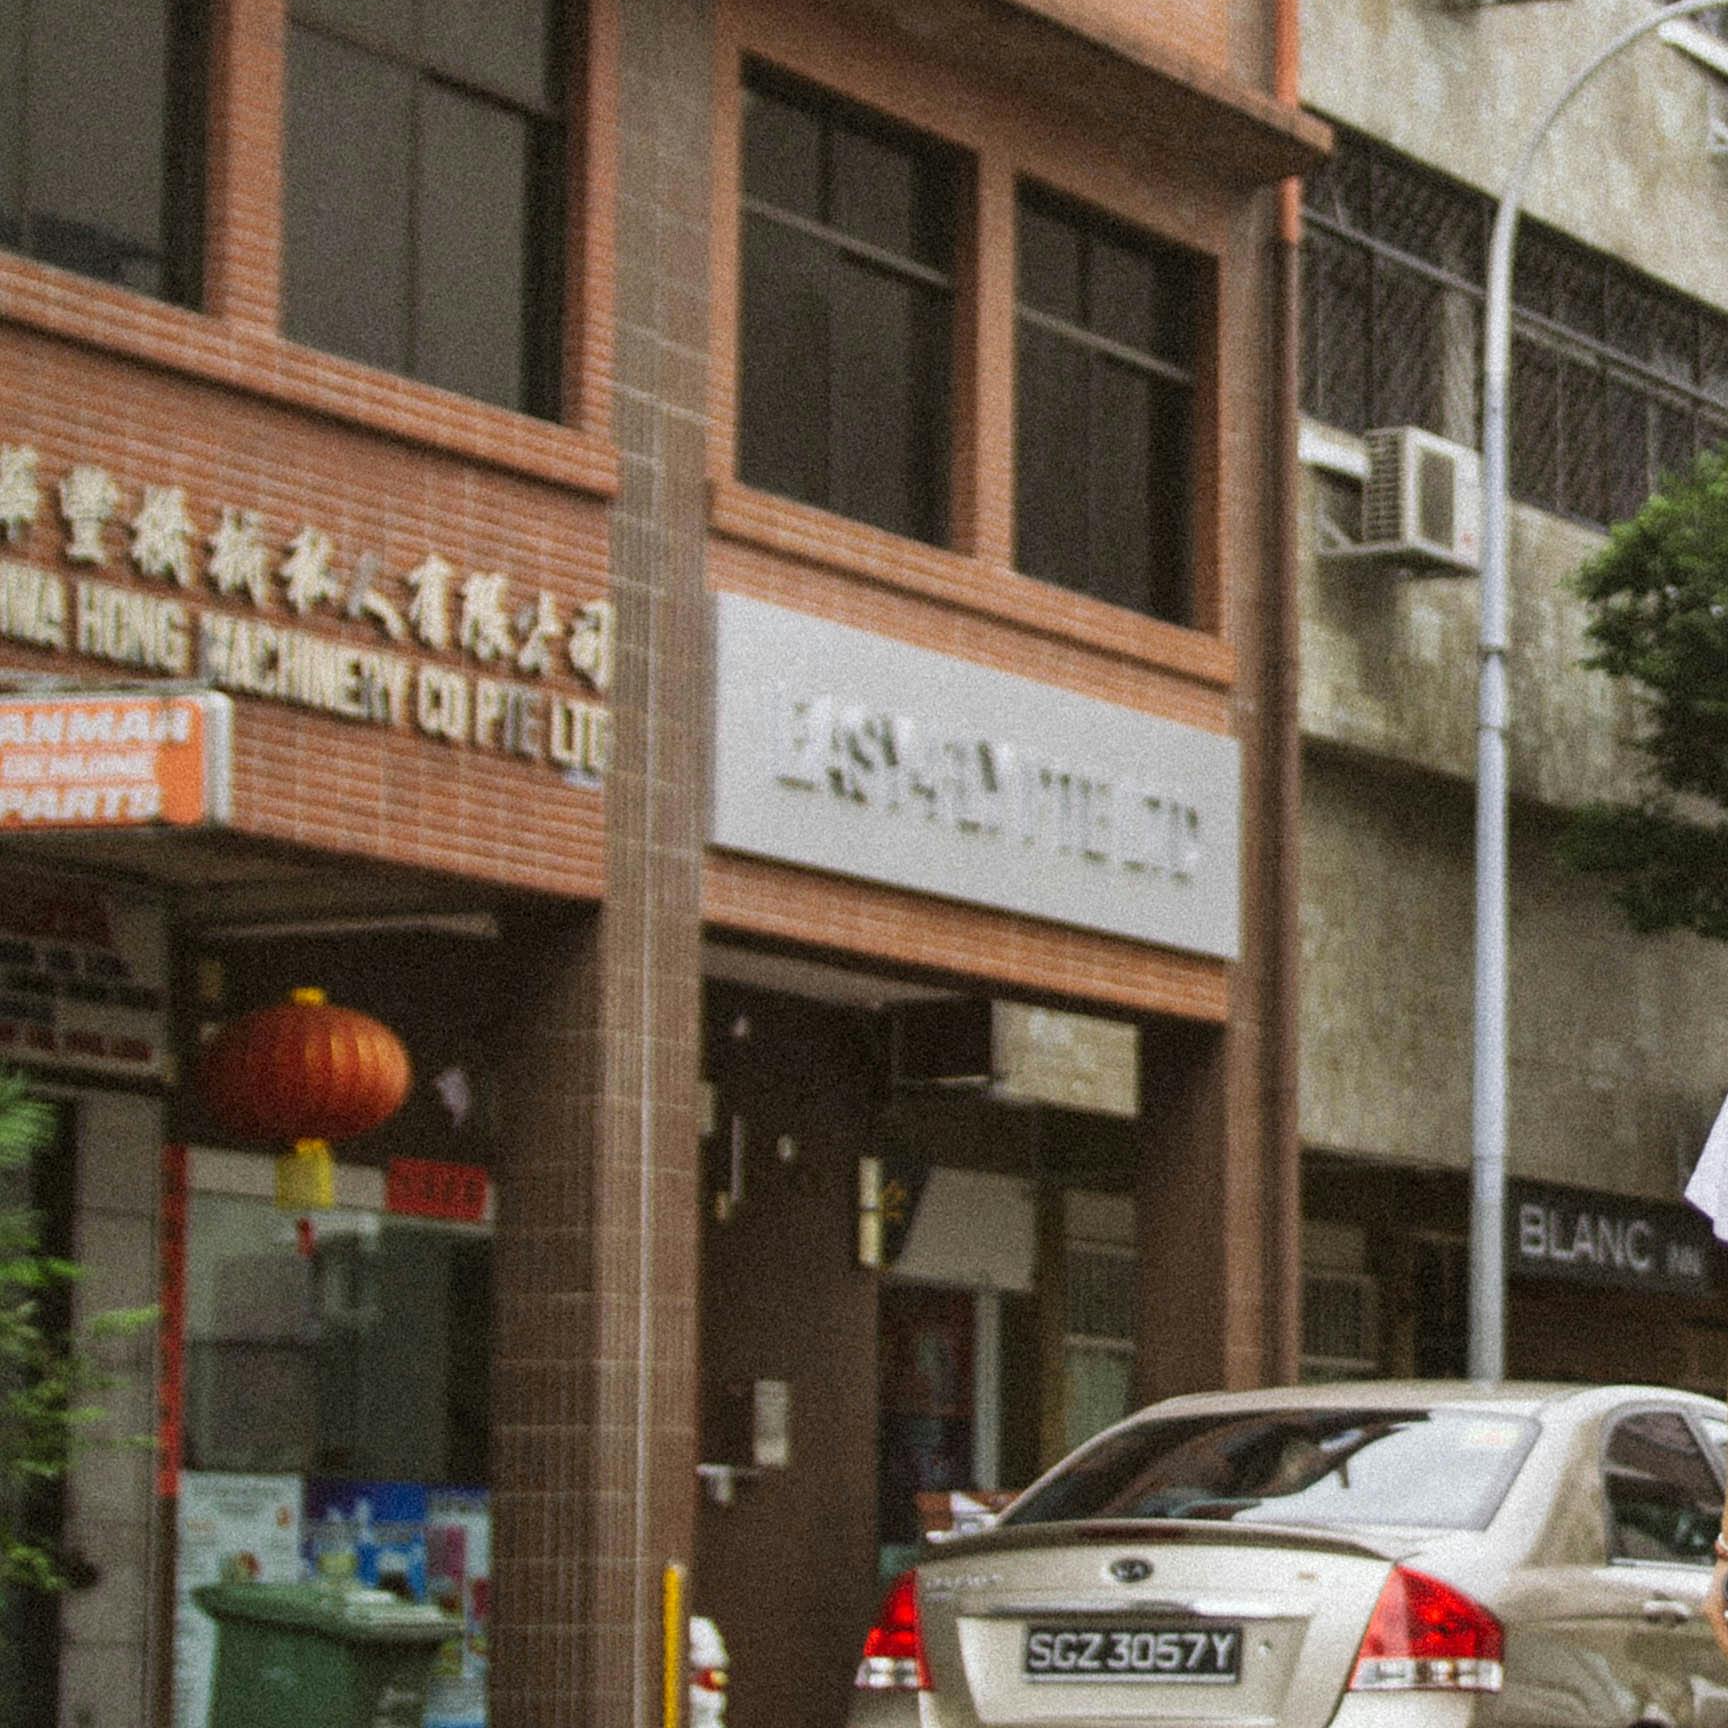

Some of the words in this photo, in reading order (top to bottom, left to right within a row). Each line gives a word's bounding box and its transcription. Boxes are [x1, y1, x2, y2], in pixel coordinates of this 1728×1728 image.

[75, 578, 192, 674] HONG
[415, 664, 472, 747] CO
[1518, 1202, 1656, 1273] BLANC
[1028, 1631, 1104, 1671] SGZ
